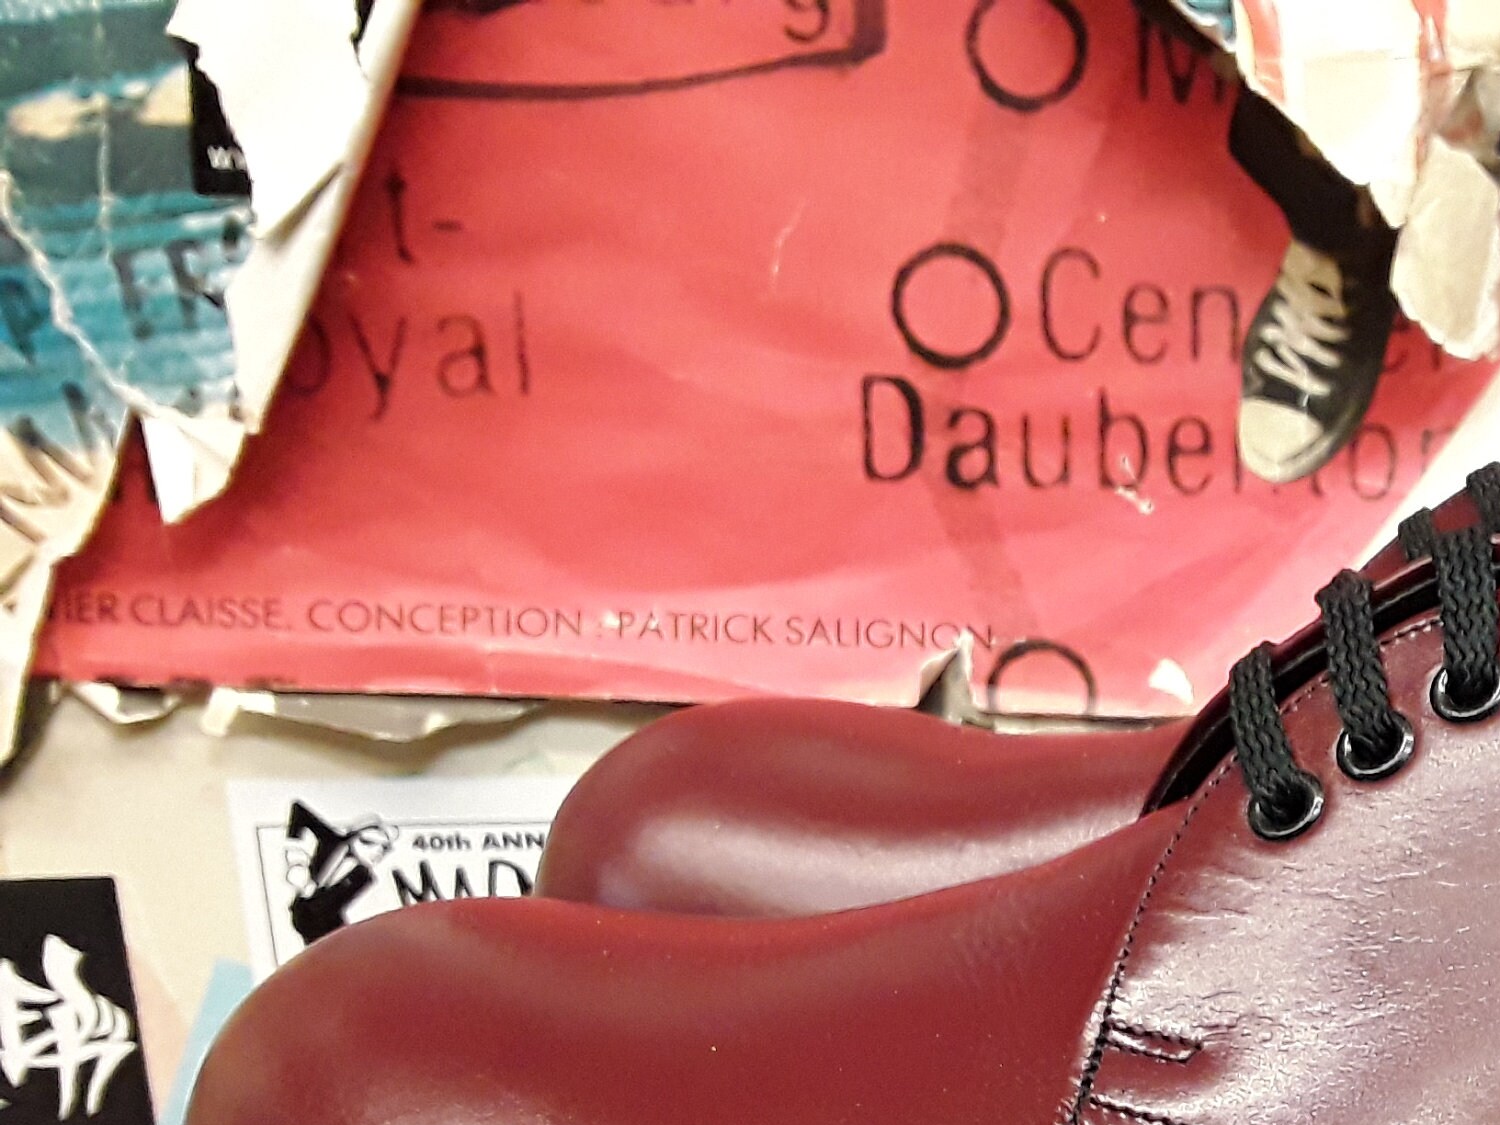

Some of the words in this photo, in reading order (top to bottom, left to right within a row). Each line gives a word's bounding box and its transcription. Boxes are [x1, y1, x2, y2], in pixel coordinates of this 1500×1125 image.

[308, 599, 582, 639] CONCEPTION
[617, 610, 774, 645] PATRICK
[785, 616, 993, 650] SALIGNON
[411, 833, 472, 850] 40th
